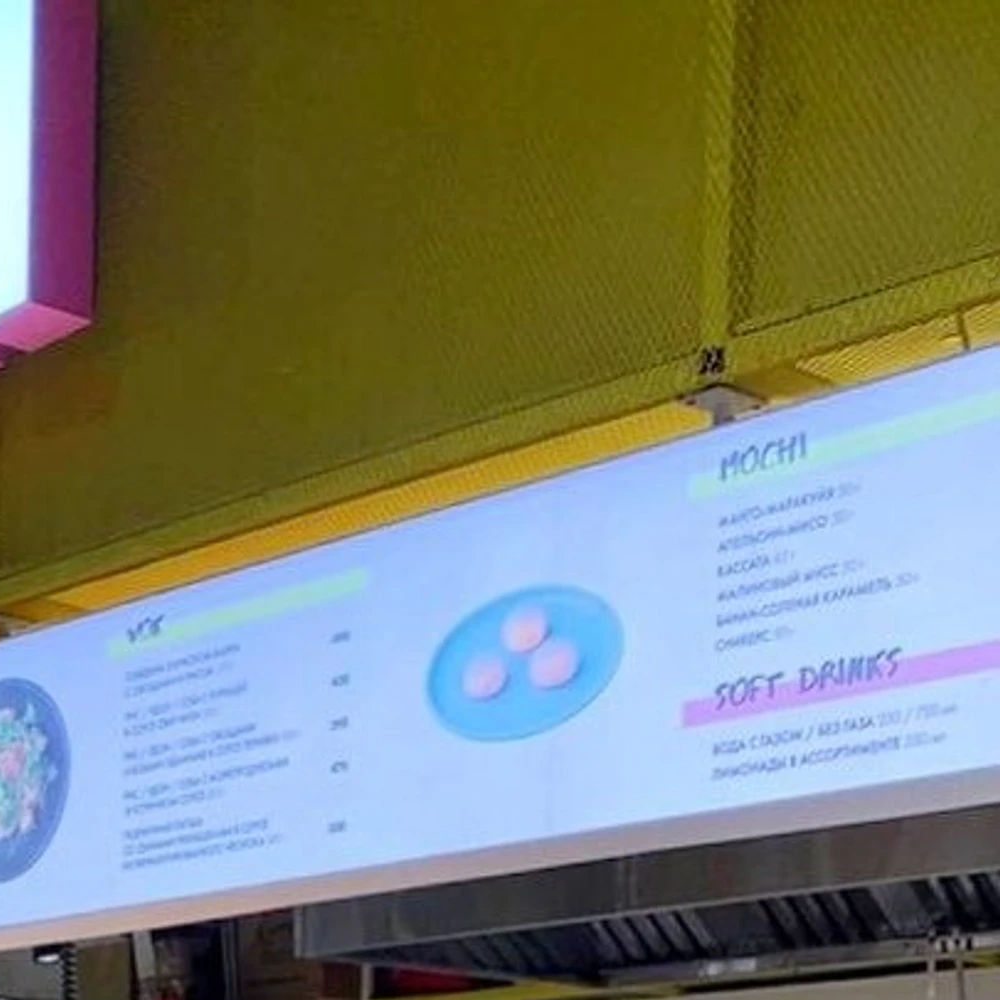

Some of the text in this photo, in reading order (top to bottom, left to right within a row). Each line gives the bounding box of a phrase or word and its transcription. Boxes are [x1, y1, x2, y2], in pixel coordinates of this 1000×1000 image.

[719, 432, 807, 481] MOCHI
[715, 647, 902, 711] SOFT DRINKS
